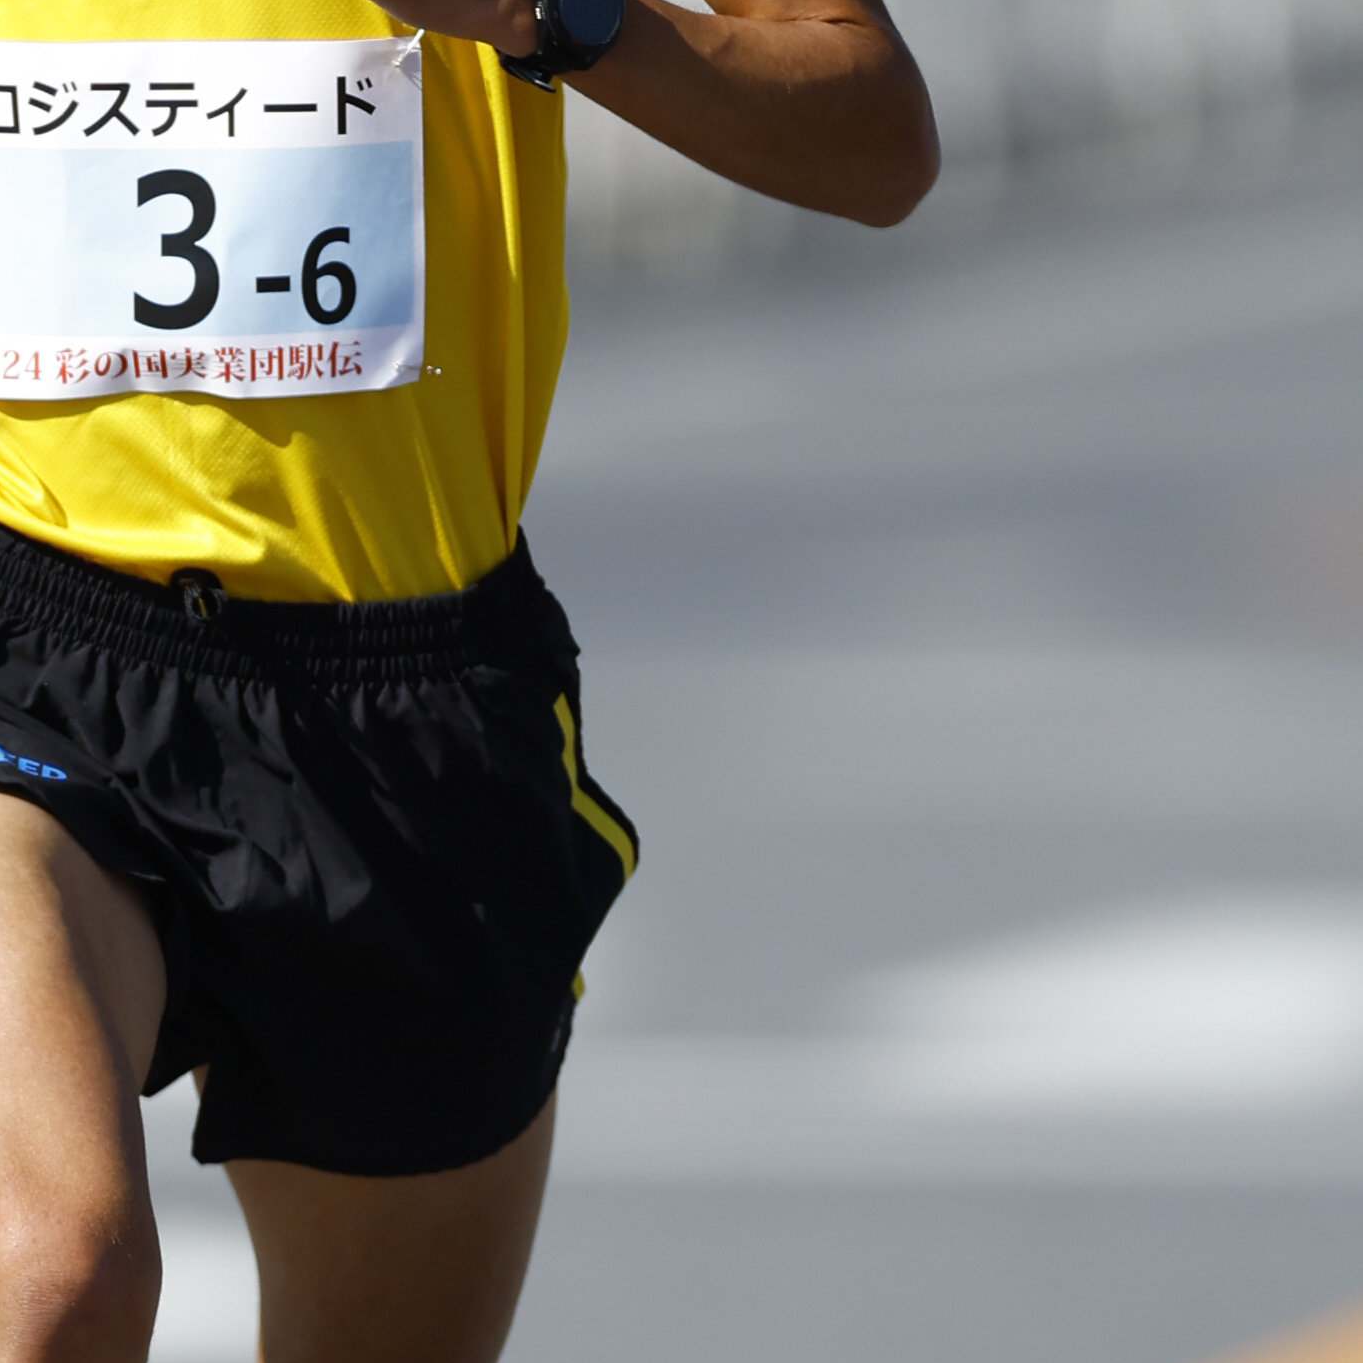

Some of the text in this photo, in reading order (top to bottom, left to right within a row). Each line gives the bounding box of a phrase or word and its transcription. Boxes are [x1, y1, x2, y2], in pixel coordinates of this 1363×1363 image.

[54, 340, 363, 384] 彩の国実業団駅伝
